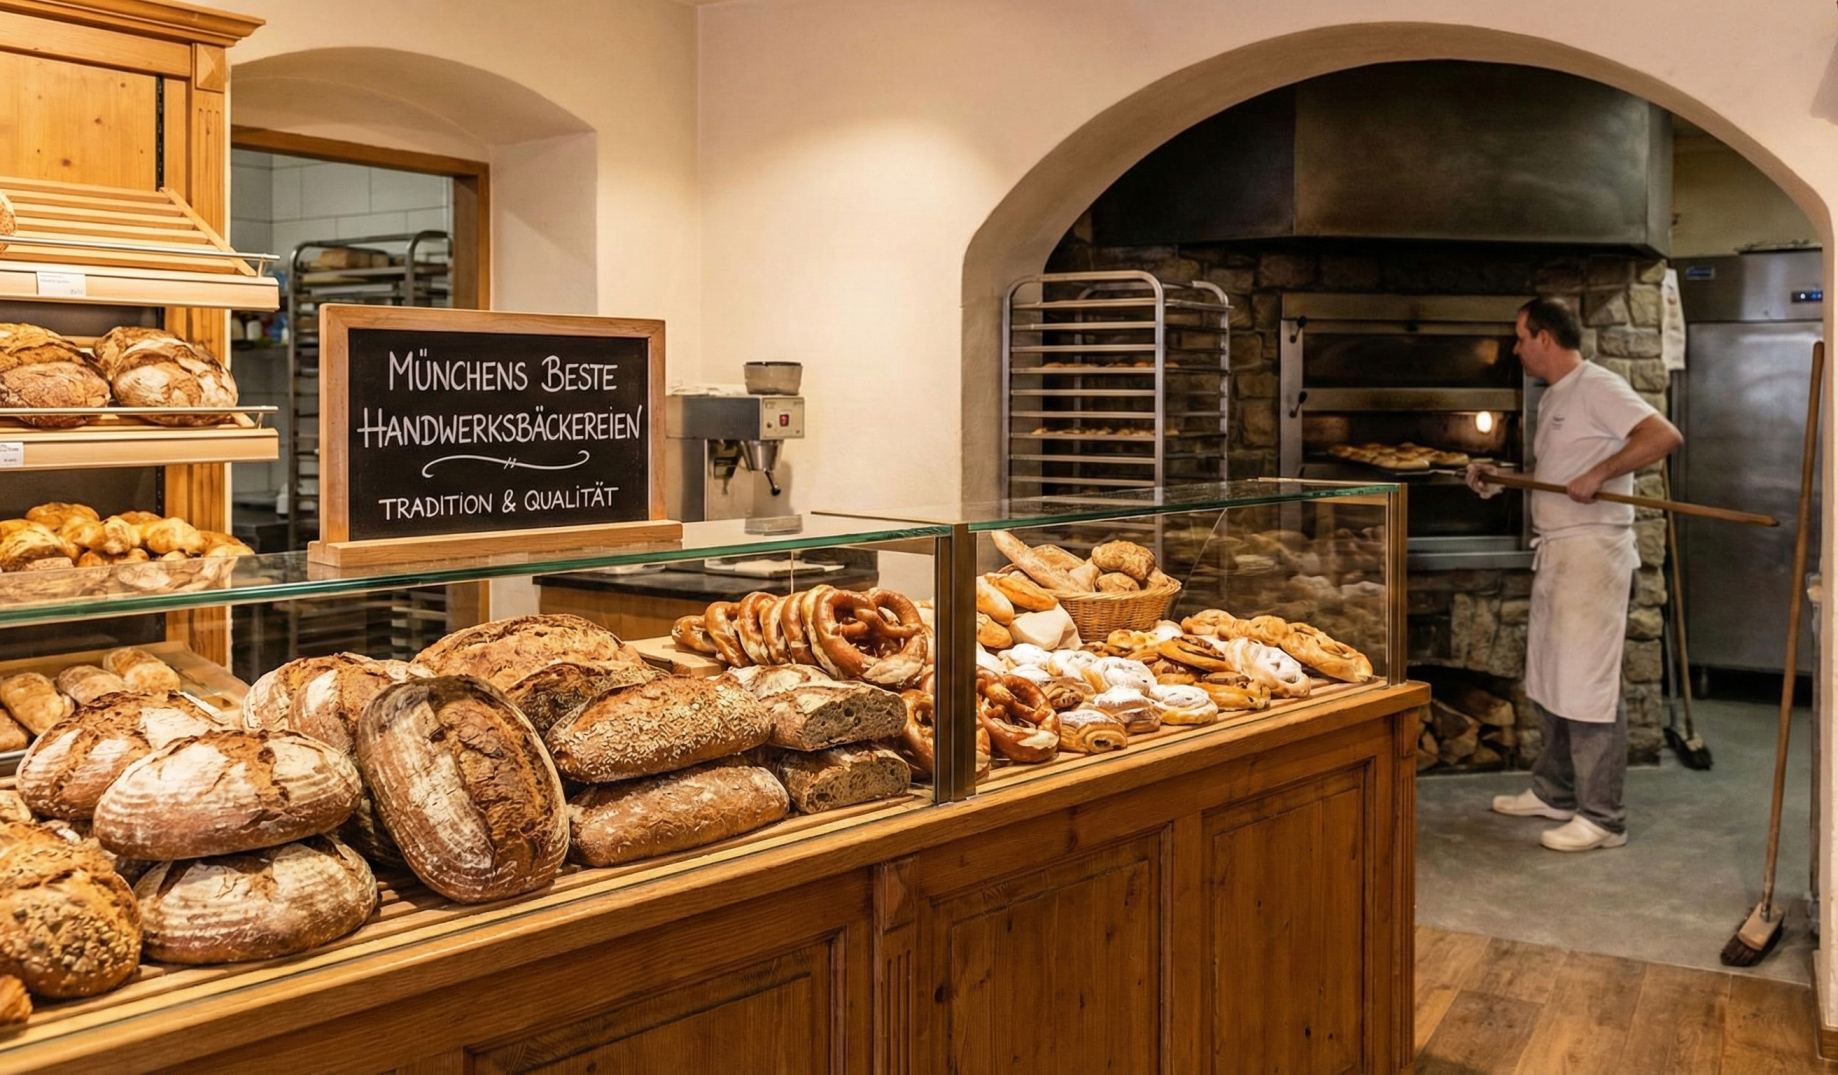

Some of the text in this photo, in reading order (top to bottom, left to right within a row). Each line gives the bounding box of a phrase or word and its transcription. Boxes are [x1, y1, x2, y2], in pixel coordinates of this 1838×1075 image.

[541, 355, 618, 393] BESTE
[378, 491, 493, 521] TRADITION
[501, 489, 517, 514] &
